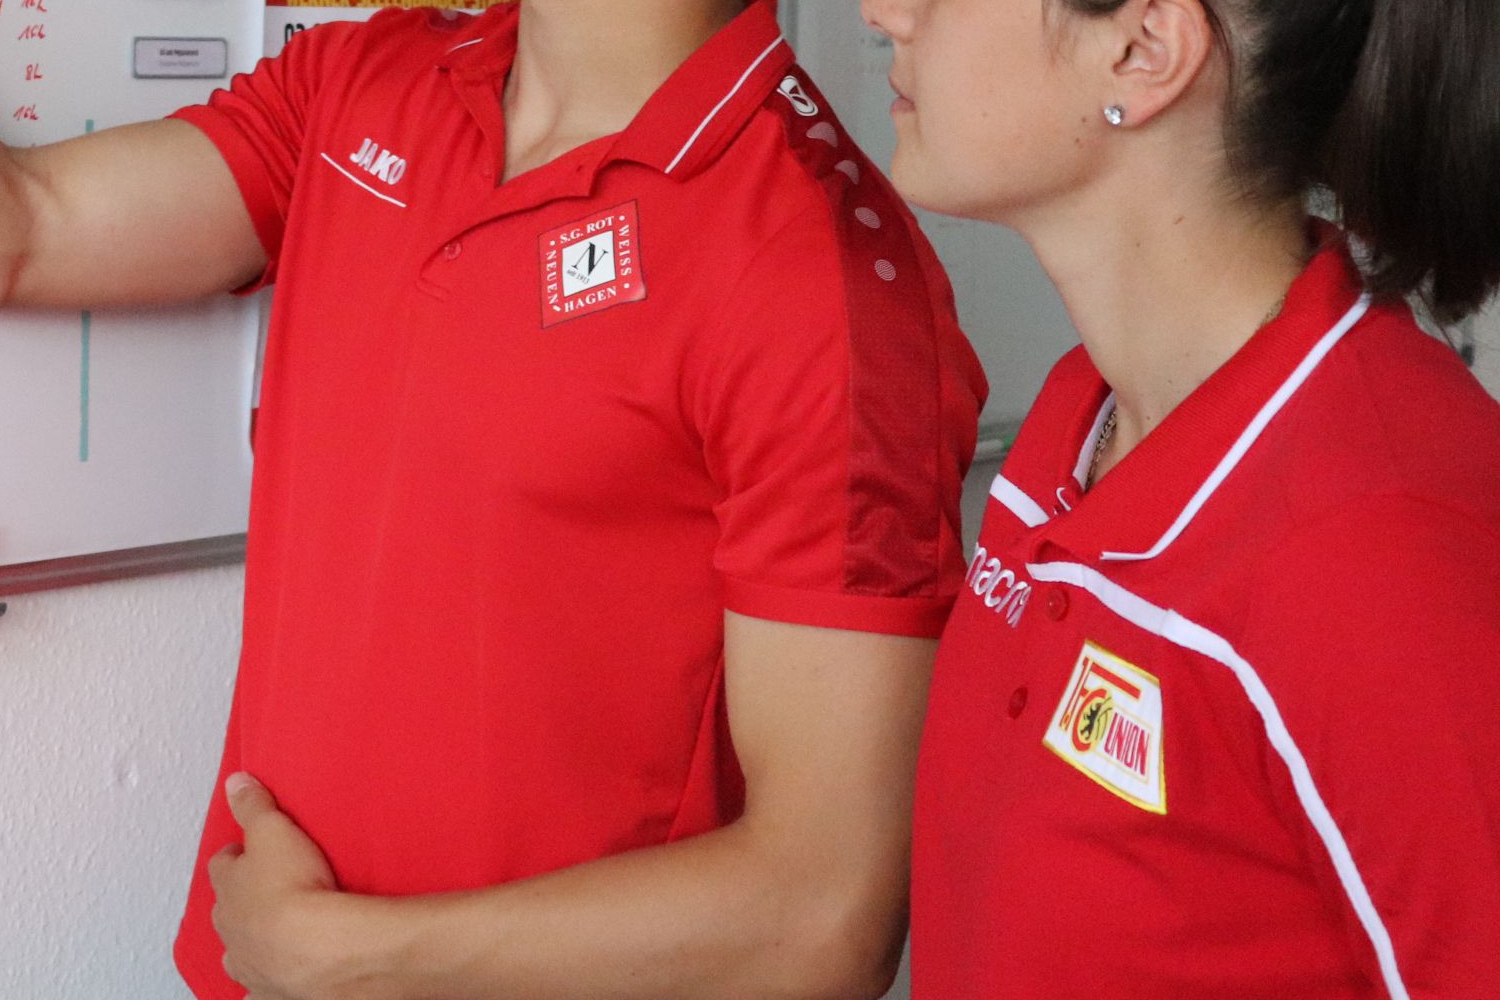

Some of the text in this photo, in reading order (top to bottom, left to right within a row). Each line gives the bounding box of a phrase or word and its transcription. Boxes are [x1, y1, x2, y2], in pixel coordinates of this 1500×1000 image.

[348, 137, 407, 185] JAKO
[560, 216, 615, 244] S.G. ROT
[618, 224, 632, 276] WEISS
[546, 250, 559, 305] NEUEN
[571, 241, 608, 276] N
[564, 286, 617, 313] HAGEN
[1103, 711, 1150, 777] UNION
